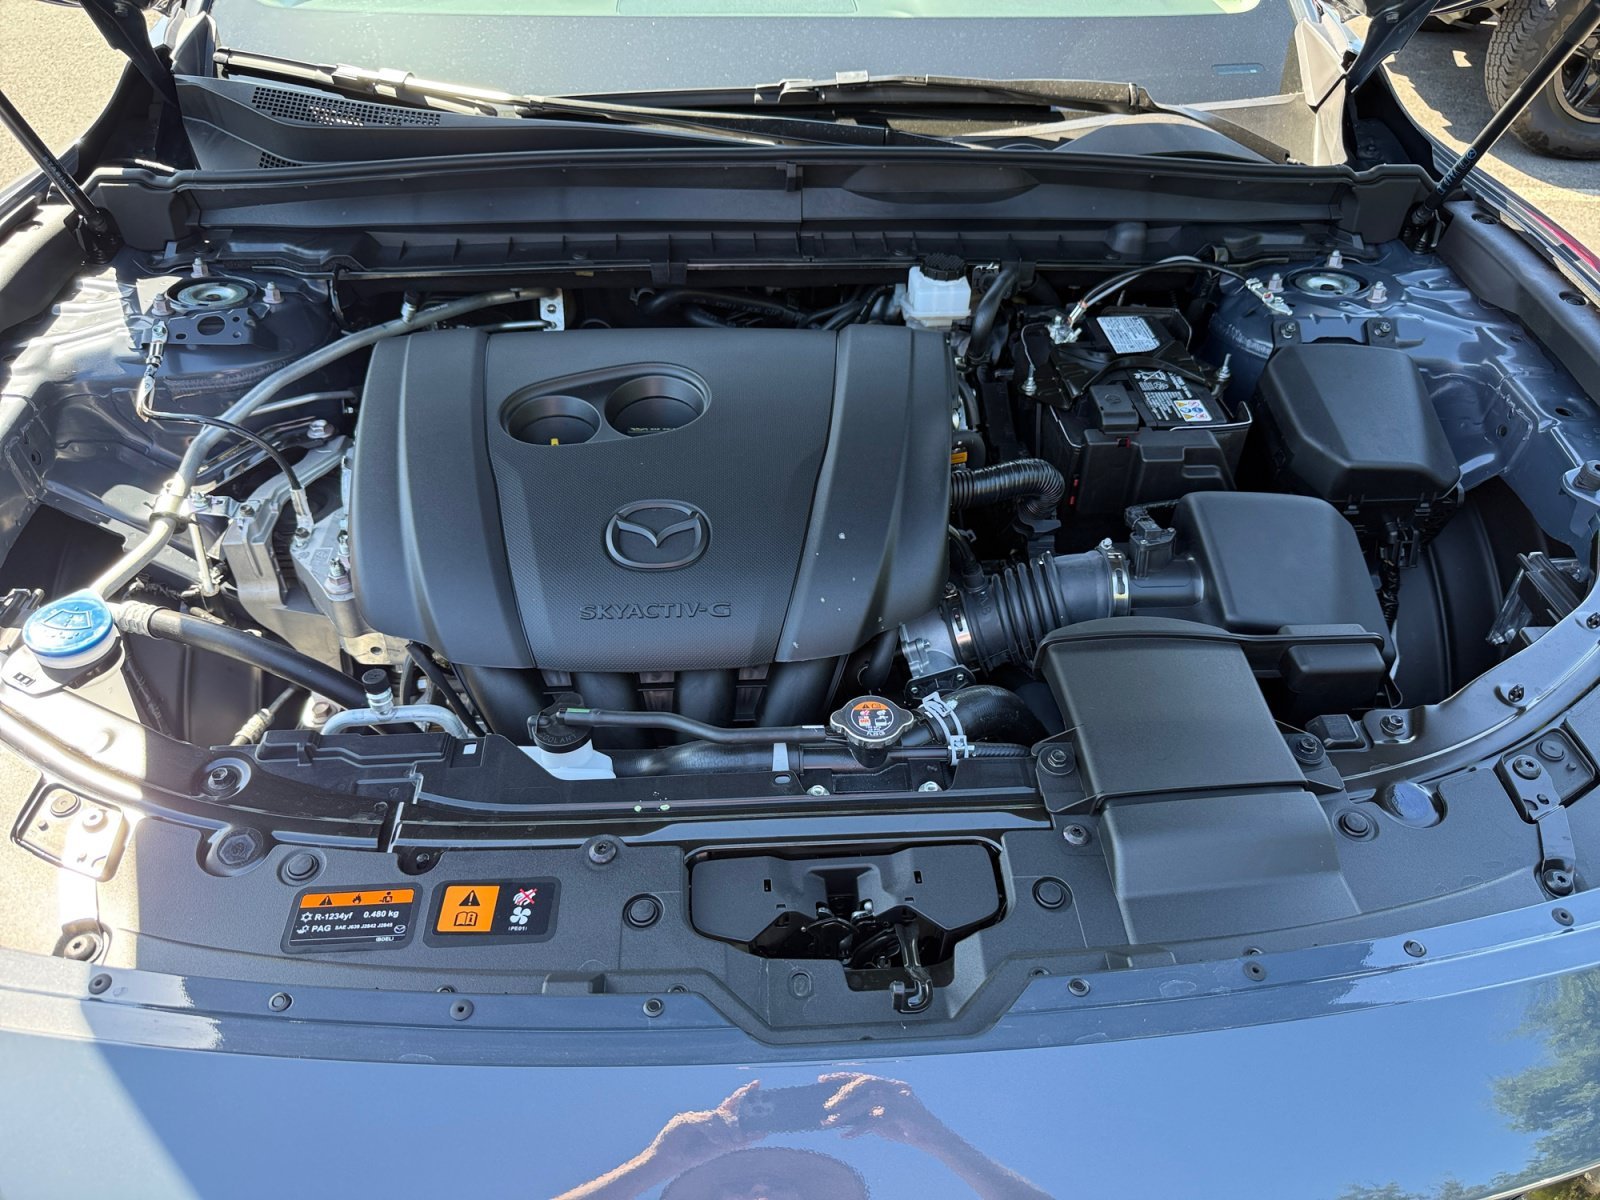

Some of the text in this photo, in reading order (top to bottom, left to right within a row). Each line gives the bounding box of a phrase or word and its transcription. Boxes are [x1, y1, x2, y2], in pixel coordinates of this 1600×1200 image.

[579, 602, 732, 620] SKYACTIV-G
[314, 909, 400, 921] R-1234yf 0.480 kg
[311, 924, 332, 933] PAG
